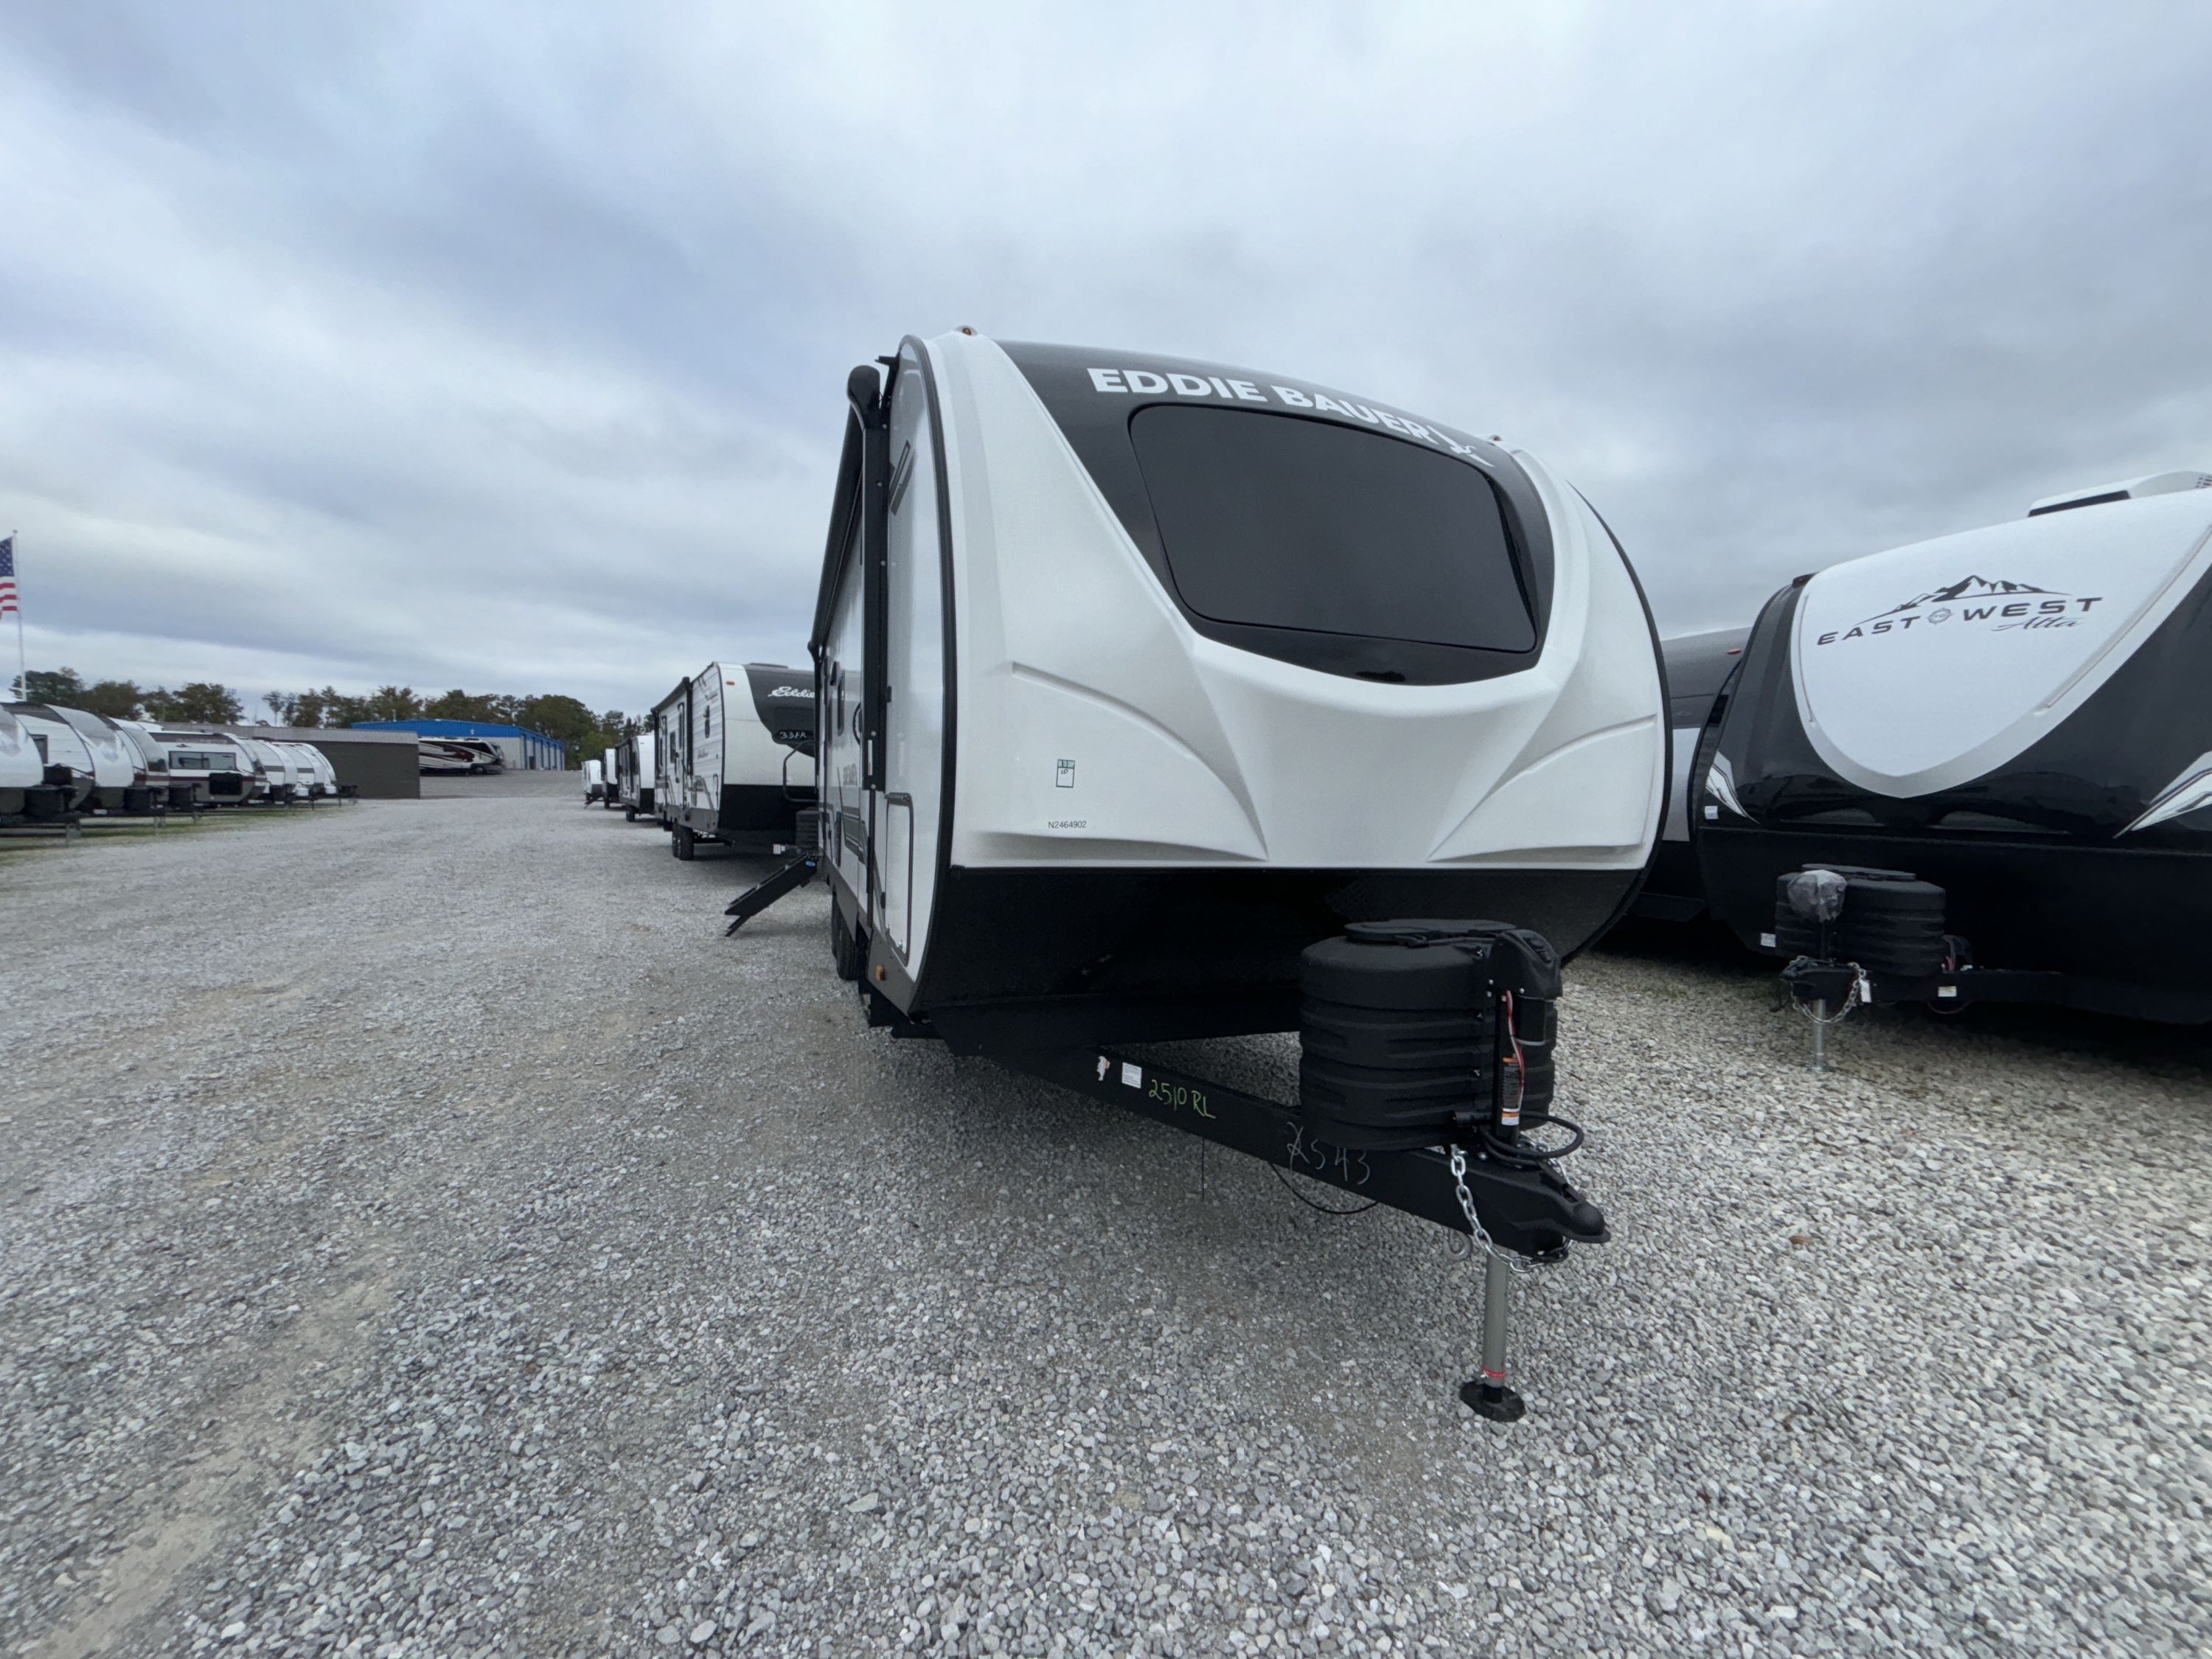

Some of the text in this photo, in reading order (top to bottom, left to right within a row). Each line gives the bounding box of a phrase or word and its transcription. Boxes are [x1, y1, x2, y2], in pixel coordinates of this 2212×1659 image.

[1087, 368, 1439, 445] EDDIE BAUER
[1816, 616, 1921, 646] EAST
[1962, 597, 2104, 622] WEST
[1048, 821, 1087, 829] N2464902
[1149, 1079, 1217, 1119] 2510 RL
